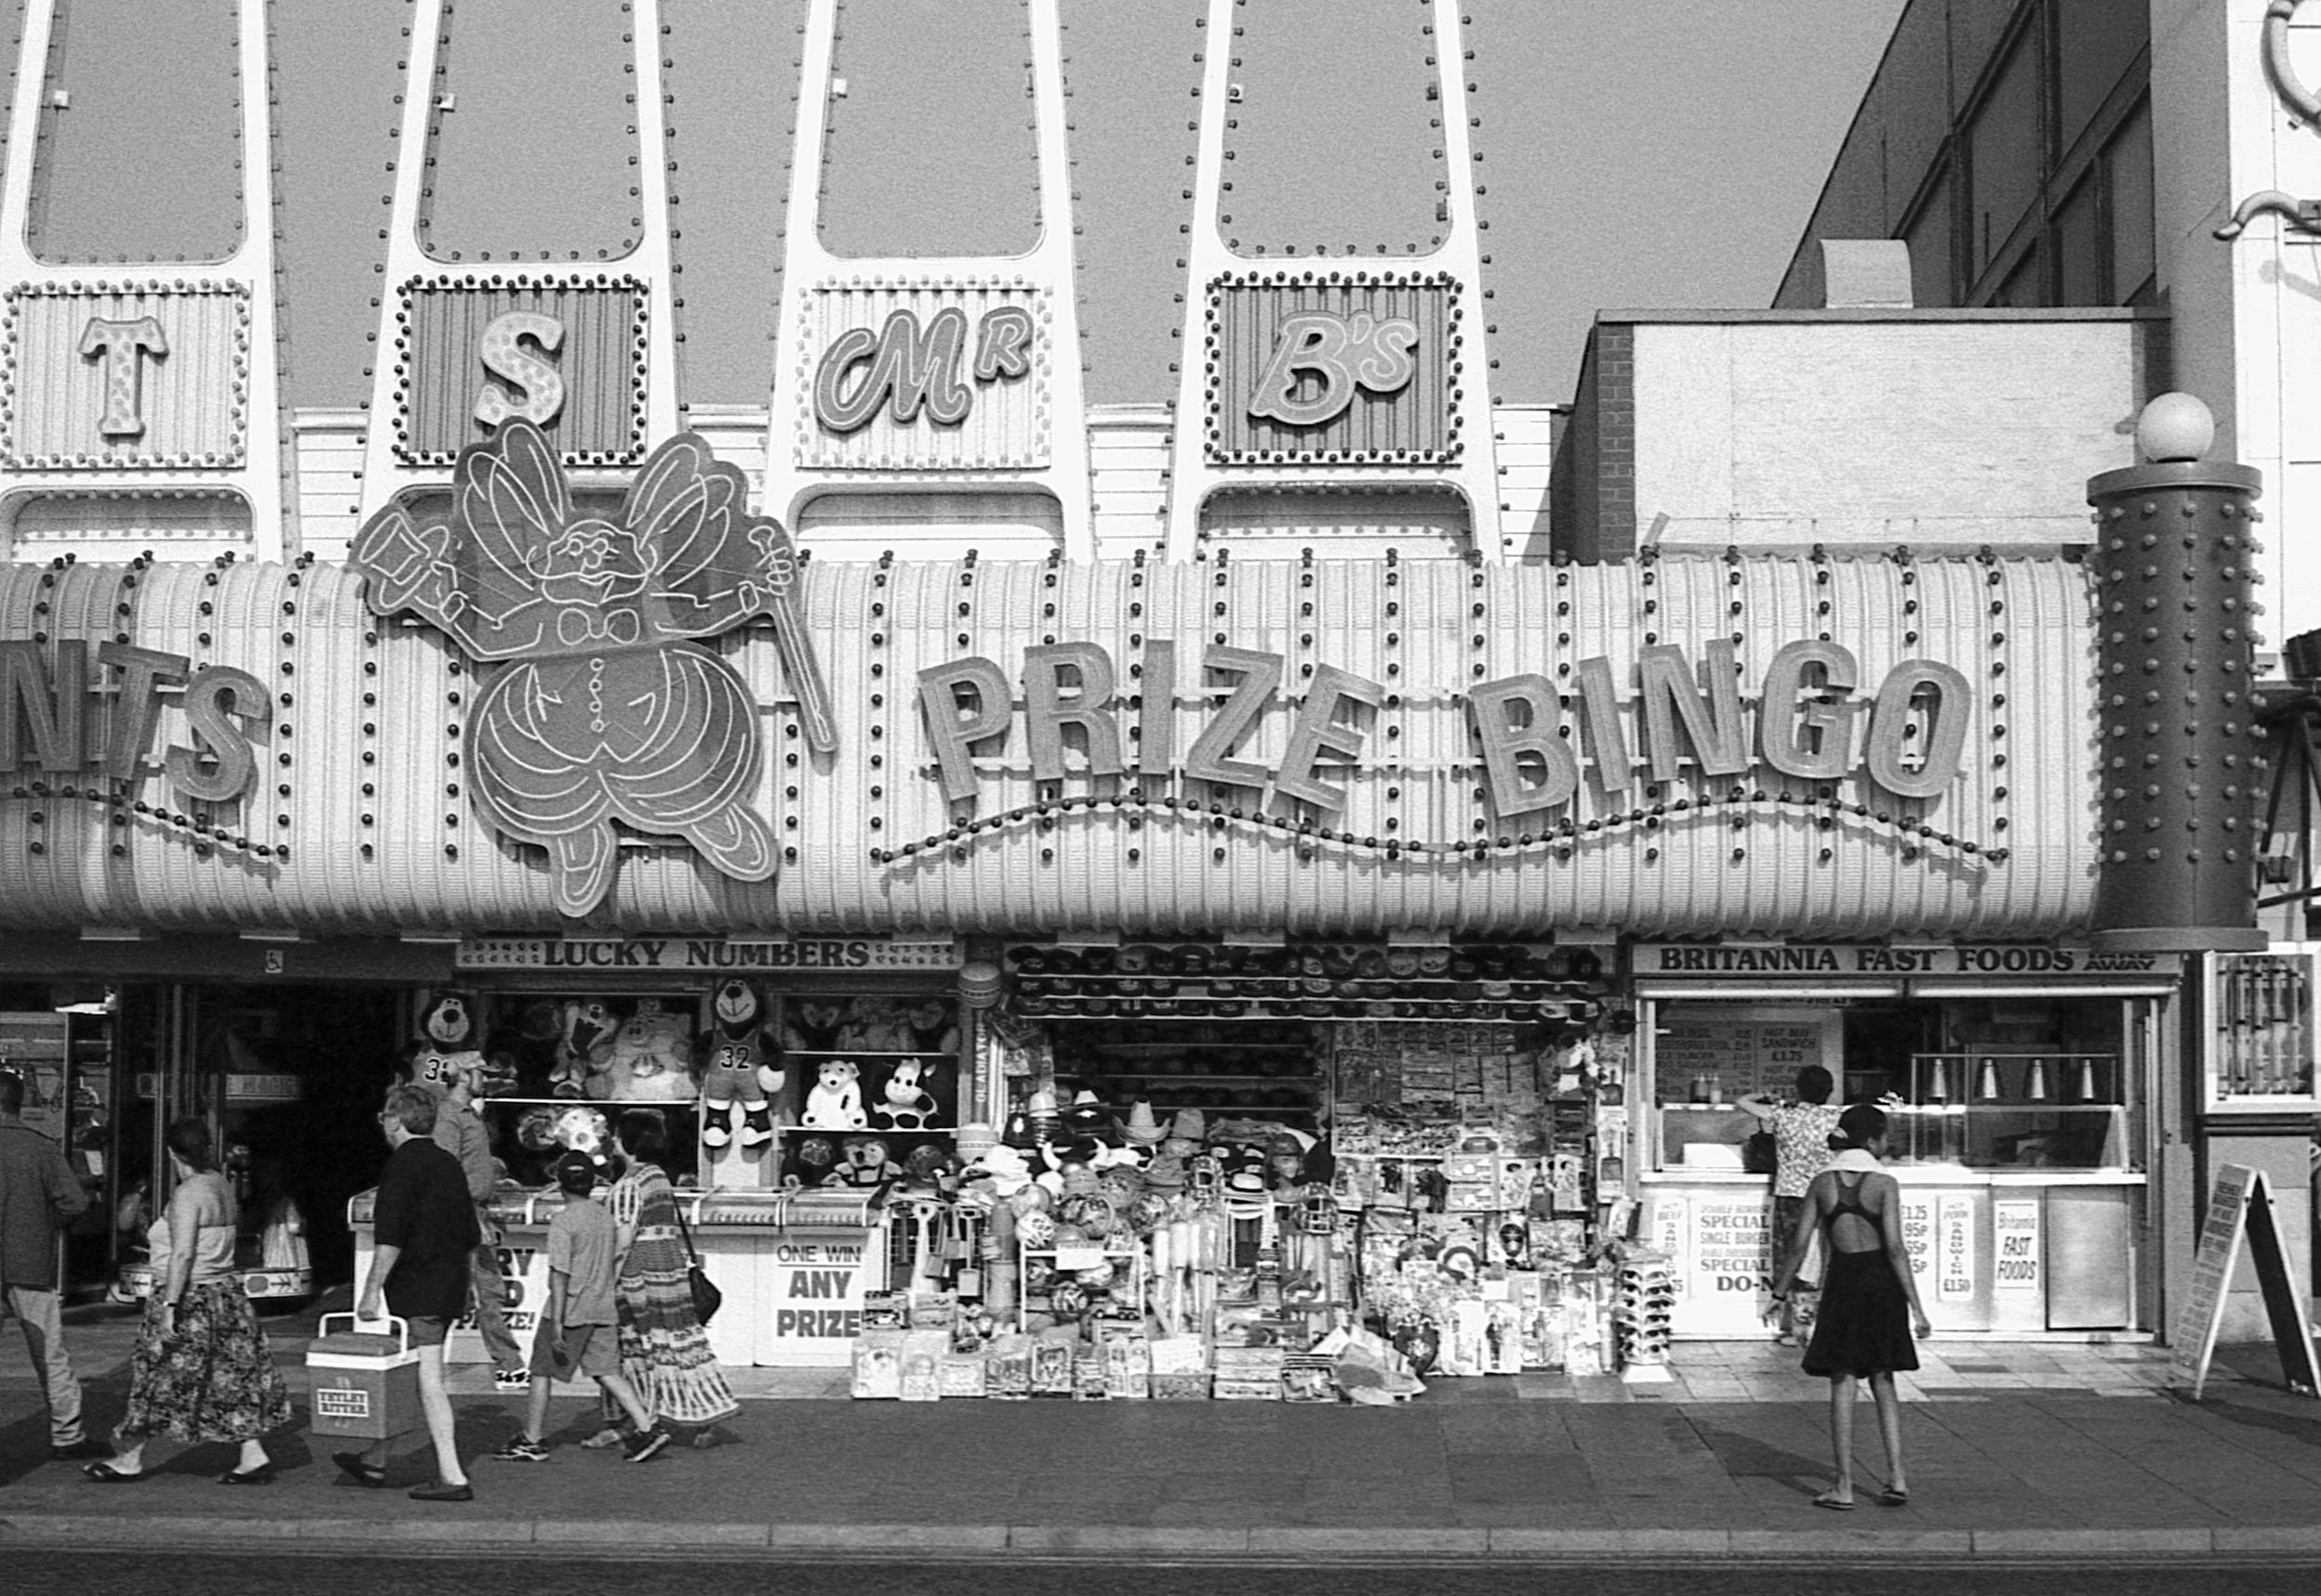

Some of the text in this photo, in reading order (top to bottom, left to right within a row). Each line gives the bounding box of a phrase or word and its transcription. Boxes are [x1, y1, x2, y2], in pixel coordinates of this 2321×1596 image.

[78, 317, 169, 436] T
[473, 311, 564, 427] S
[916, 638, 1972, 817] PRIZE BINGO
[544, 941, 667, 967] LUCKY
[686, 941, 869, 967] NUMBERS
[1659, 947, 2074, 971] BRITANNIA FAST FOODS
[2082, 960, 2156, 971] AWAY
[720, 1045, 751, 1070] 32
[975, 1022, 988, 1103] GLADIATOR
[1700, 1215, 1770, 1228] SPECIAL
[777, 1245, 862, 1262] ONE WIN
[2003, 1236, 2032, 1256] FAST
[1700, 1259, 1770, 1272] SPECIAL
[1997, 1260, 2037, 1280] FOODS
[788, 1270, 852, 1299] ANY
[777, 1309, 862, 1337] PRIZE
